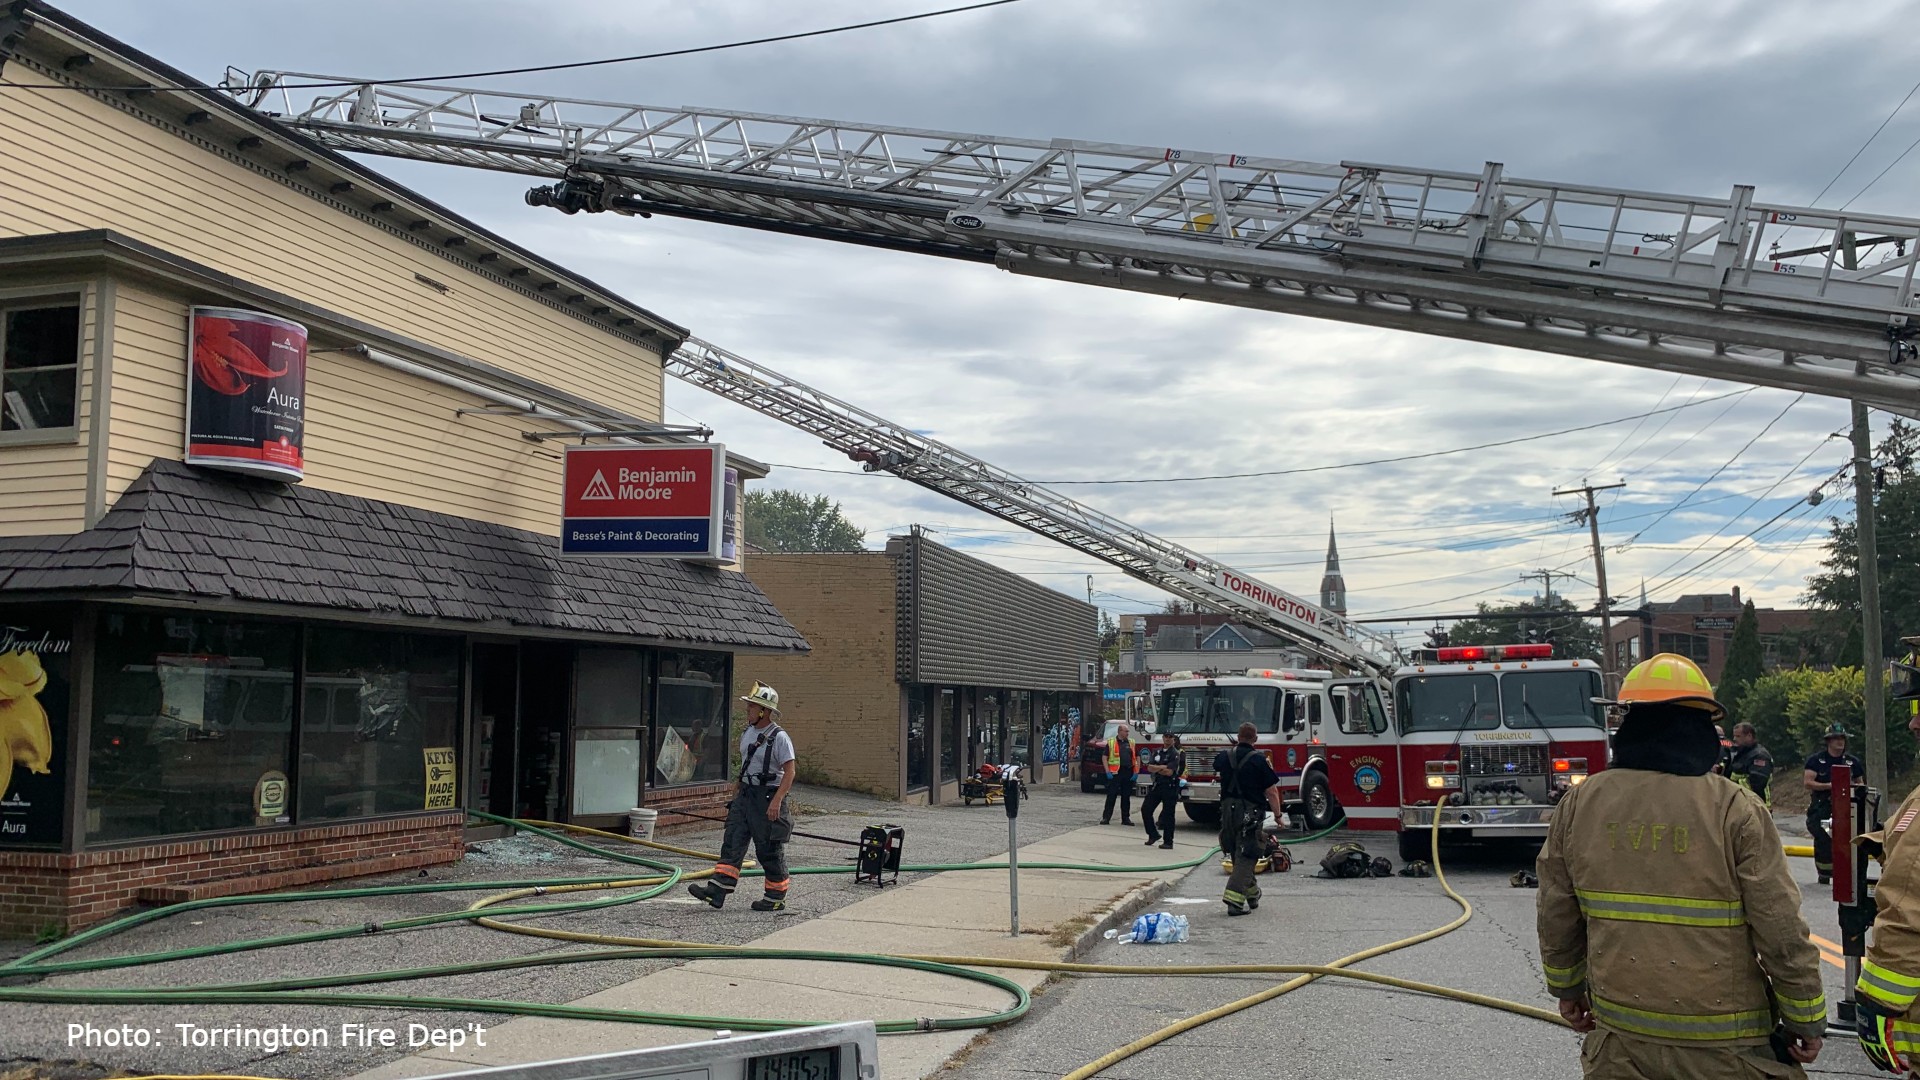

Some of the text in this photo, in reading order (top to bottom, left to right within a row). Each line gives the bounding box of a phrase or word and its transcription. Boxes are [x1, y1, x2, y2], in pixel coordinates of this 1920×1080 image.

[1169, 150, 1181, 159] 78
[1235, 156, 1248, 165] 75
[956, 217, 979, 227] E-ONE
[1780, 264, 1796, 273] 55
[267, 386, 300, 410] Aura
[618, 466, 696, 486] Benjamin
[618, 485, 673, 500] Moore
[572, 530, 699, 543] Besse's Paint & Decorating
[1222, 572, 1317, 625] TORRINGTON
[0, 625, 70, 653] Freedom
[1473, 731, 1532, 741] TORRINGTON
[426, 751, 454, 765] KEYS
[1349, 755, 1384, 768] ENGINE
[428, 782, 454, 795] MADE
[428, 794, 453, 808] HERE
[1365, 794, 1371, 802] 3
[1, 820, 27, 834] Aura
